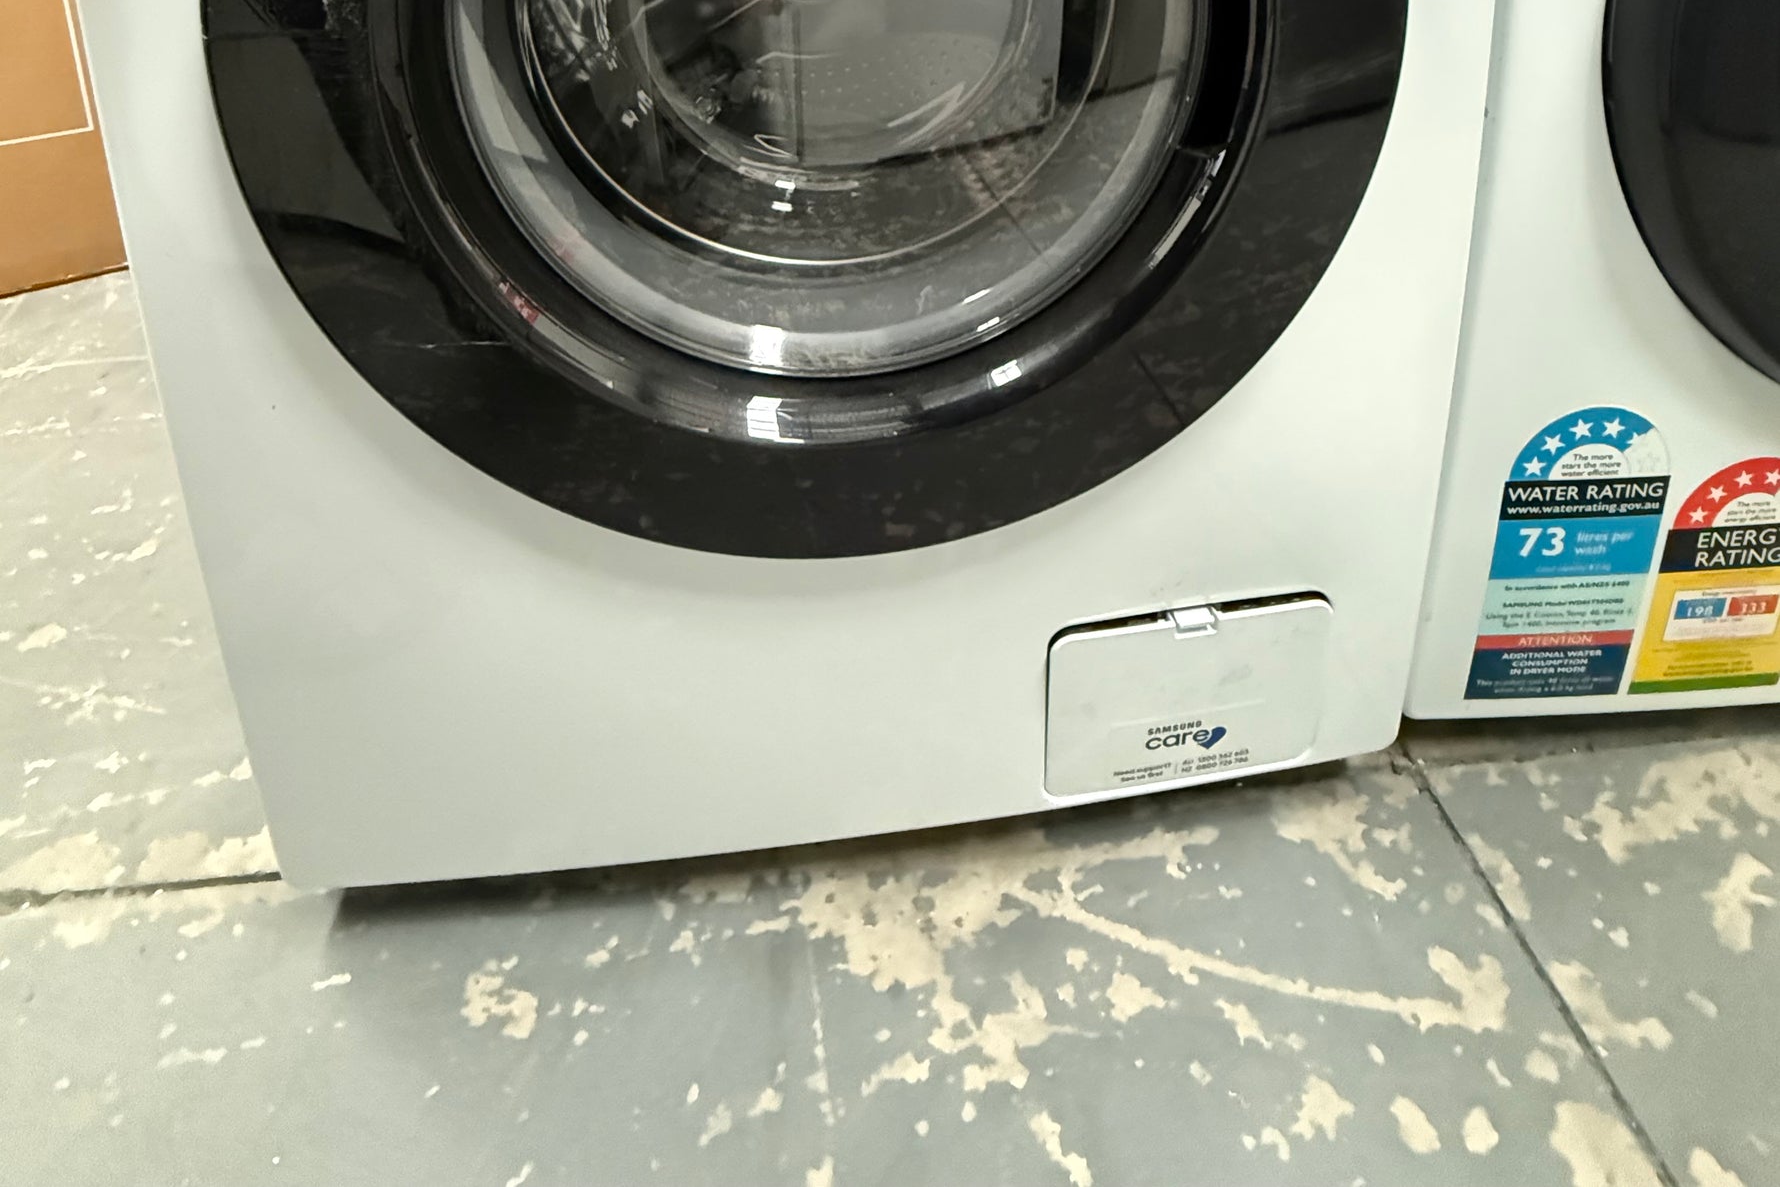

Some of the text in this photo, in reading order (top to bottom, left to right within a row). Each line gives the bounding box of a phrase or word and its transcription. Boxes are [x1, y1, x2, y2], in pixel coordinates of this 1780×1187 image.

[1573, 453, 1589, 461] The
[1507, 482, 1665, 502] WATER RATING
[1506, 501, 1660, 514] www.waterrating.gov.au
[1519, 526, 1567, 558] 73
[1576, 531, 1635, 544] litres per
[1697, 528, 1780, 549] ENERG
[1574, 544, 1607, 555] wash
[1518, 634, 1594, 647] ATTENTION
[1502, 649, 1602, 660] ADDITIONAL WATER
[1512, 658, 1588, 667] CONSUMPTION
[1523, 667, 1555, 675] DRYER
[1557, 666, 1587, 674] MODE
[1148, 720, 1203, 735] SAMSUNG
[1145, 729, 1211, 750] care
